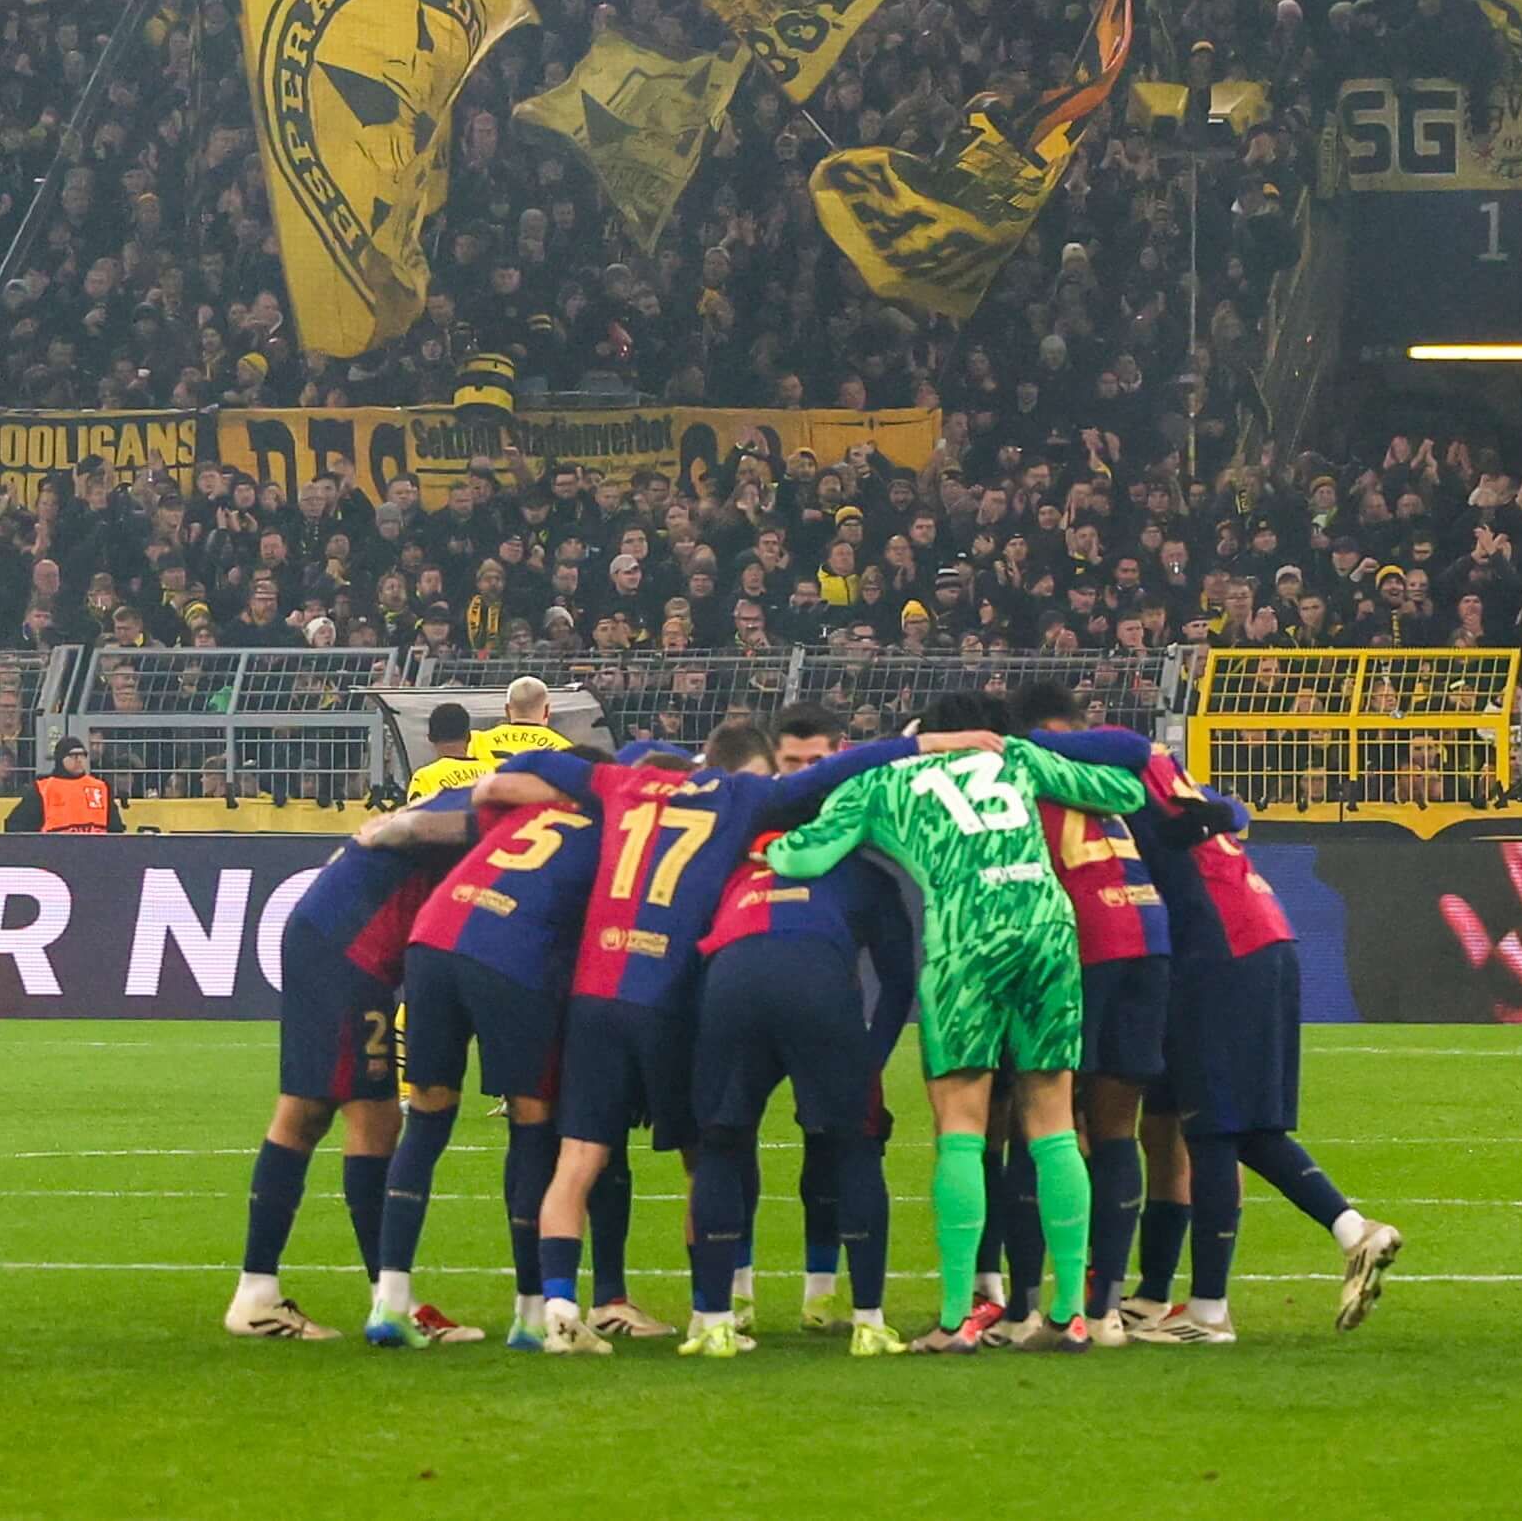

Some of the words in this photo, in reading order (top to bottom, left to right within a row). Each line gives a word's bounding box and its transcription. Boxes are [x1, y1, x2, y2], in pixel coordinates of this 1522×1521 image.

[1341, 89, 1457, 176] SG
[910, 751, 1030, 836] 13
[486, 808, 593, 871] 5
[610, 801, 717, 907] 17
